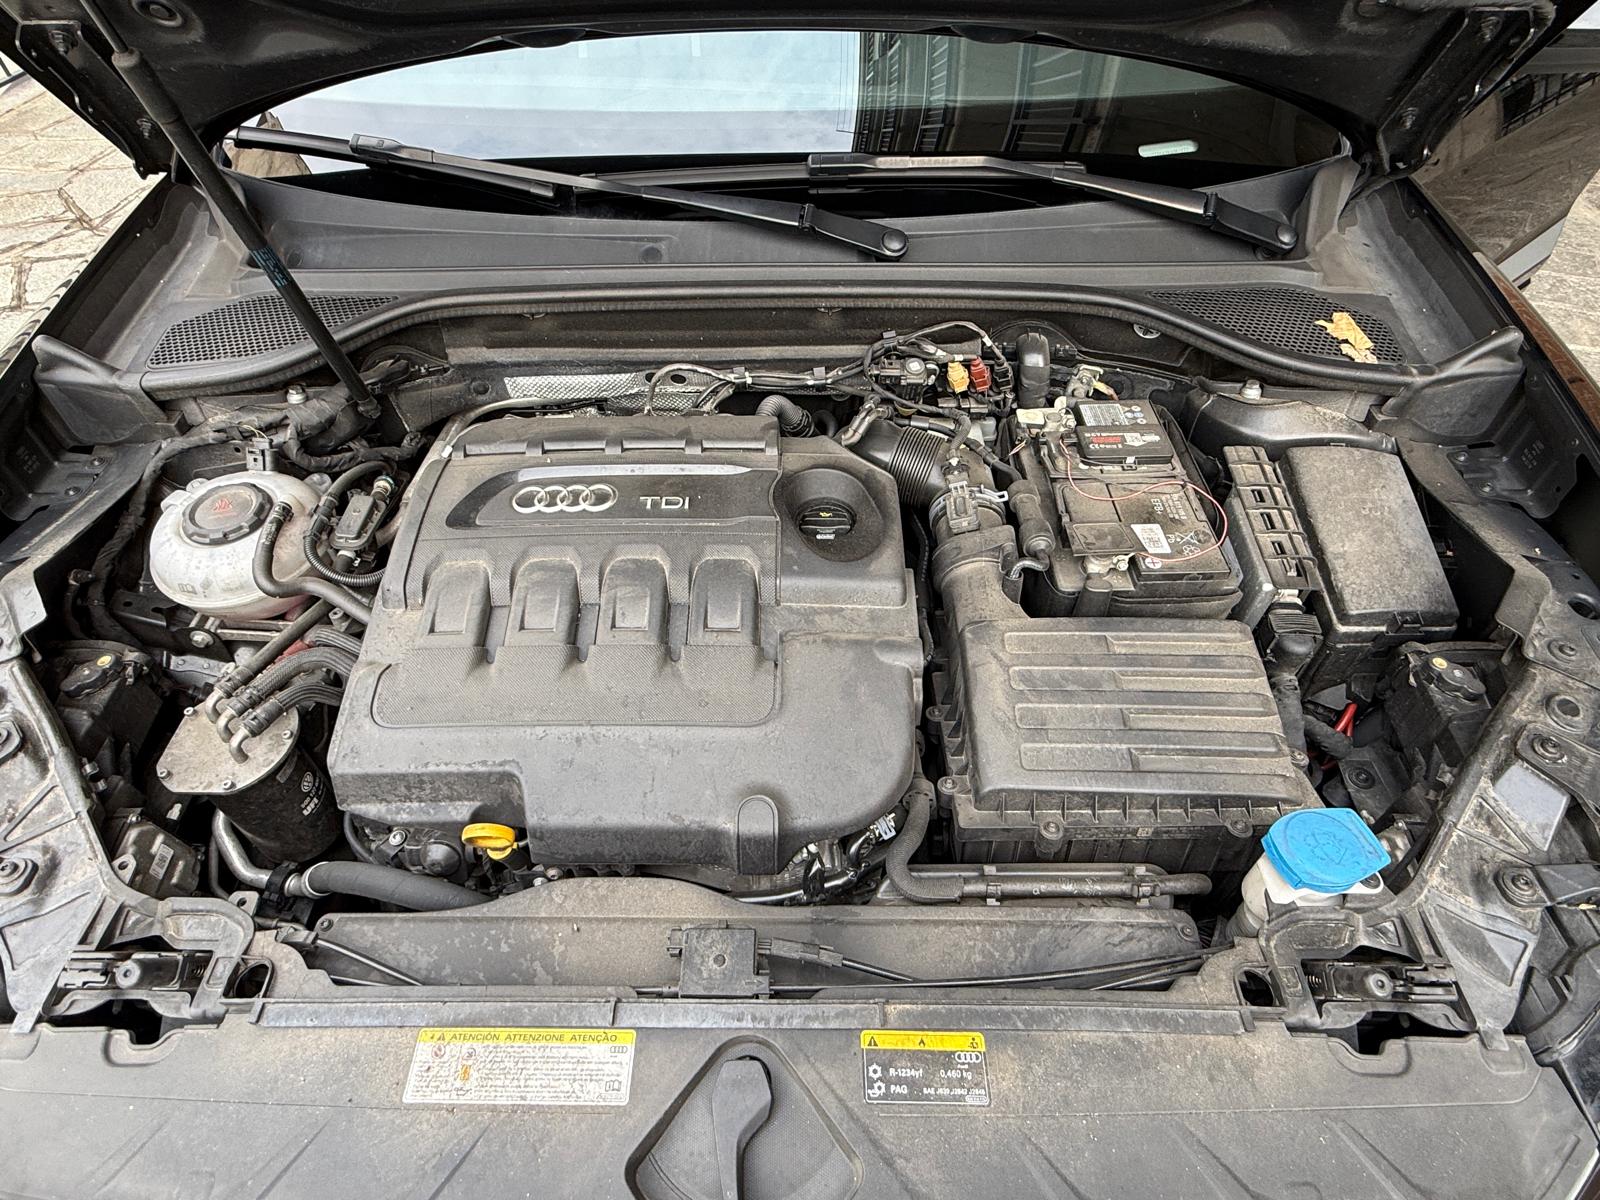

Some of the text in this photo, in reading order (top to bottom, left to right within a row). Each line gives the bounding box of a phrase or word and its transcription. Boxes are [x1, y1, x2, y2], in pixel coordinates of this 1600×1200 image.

[640, 496, 690, 510] TDI
[1151, 498, 1164, 515] EFB+
[302, 797, 319, 816] UFI
[450, 1031, 618, 1043] ATENCIÓN ATTENZIONE ATENÇÃO
[889, 1068, 923, 1079] R-1234yf
[962, 1070, 972, 1080] kg
[890, 1084, 908, 1094] PAG
